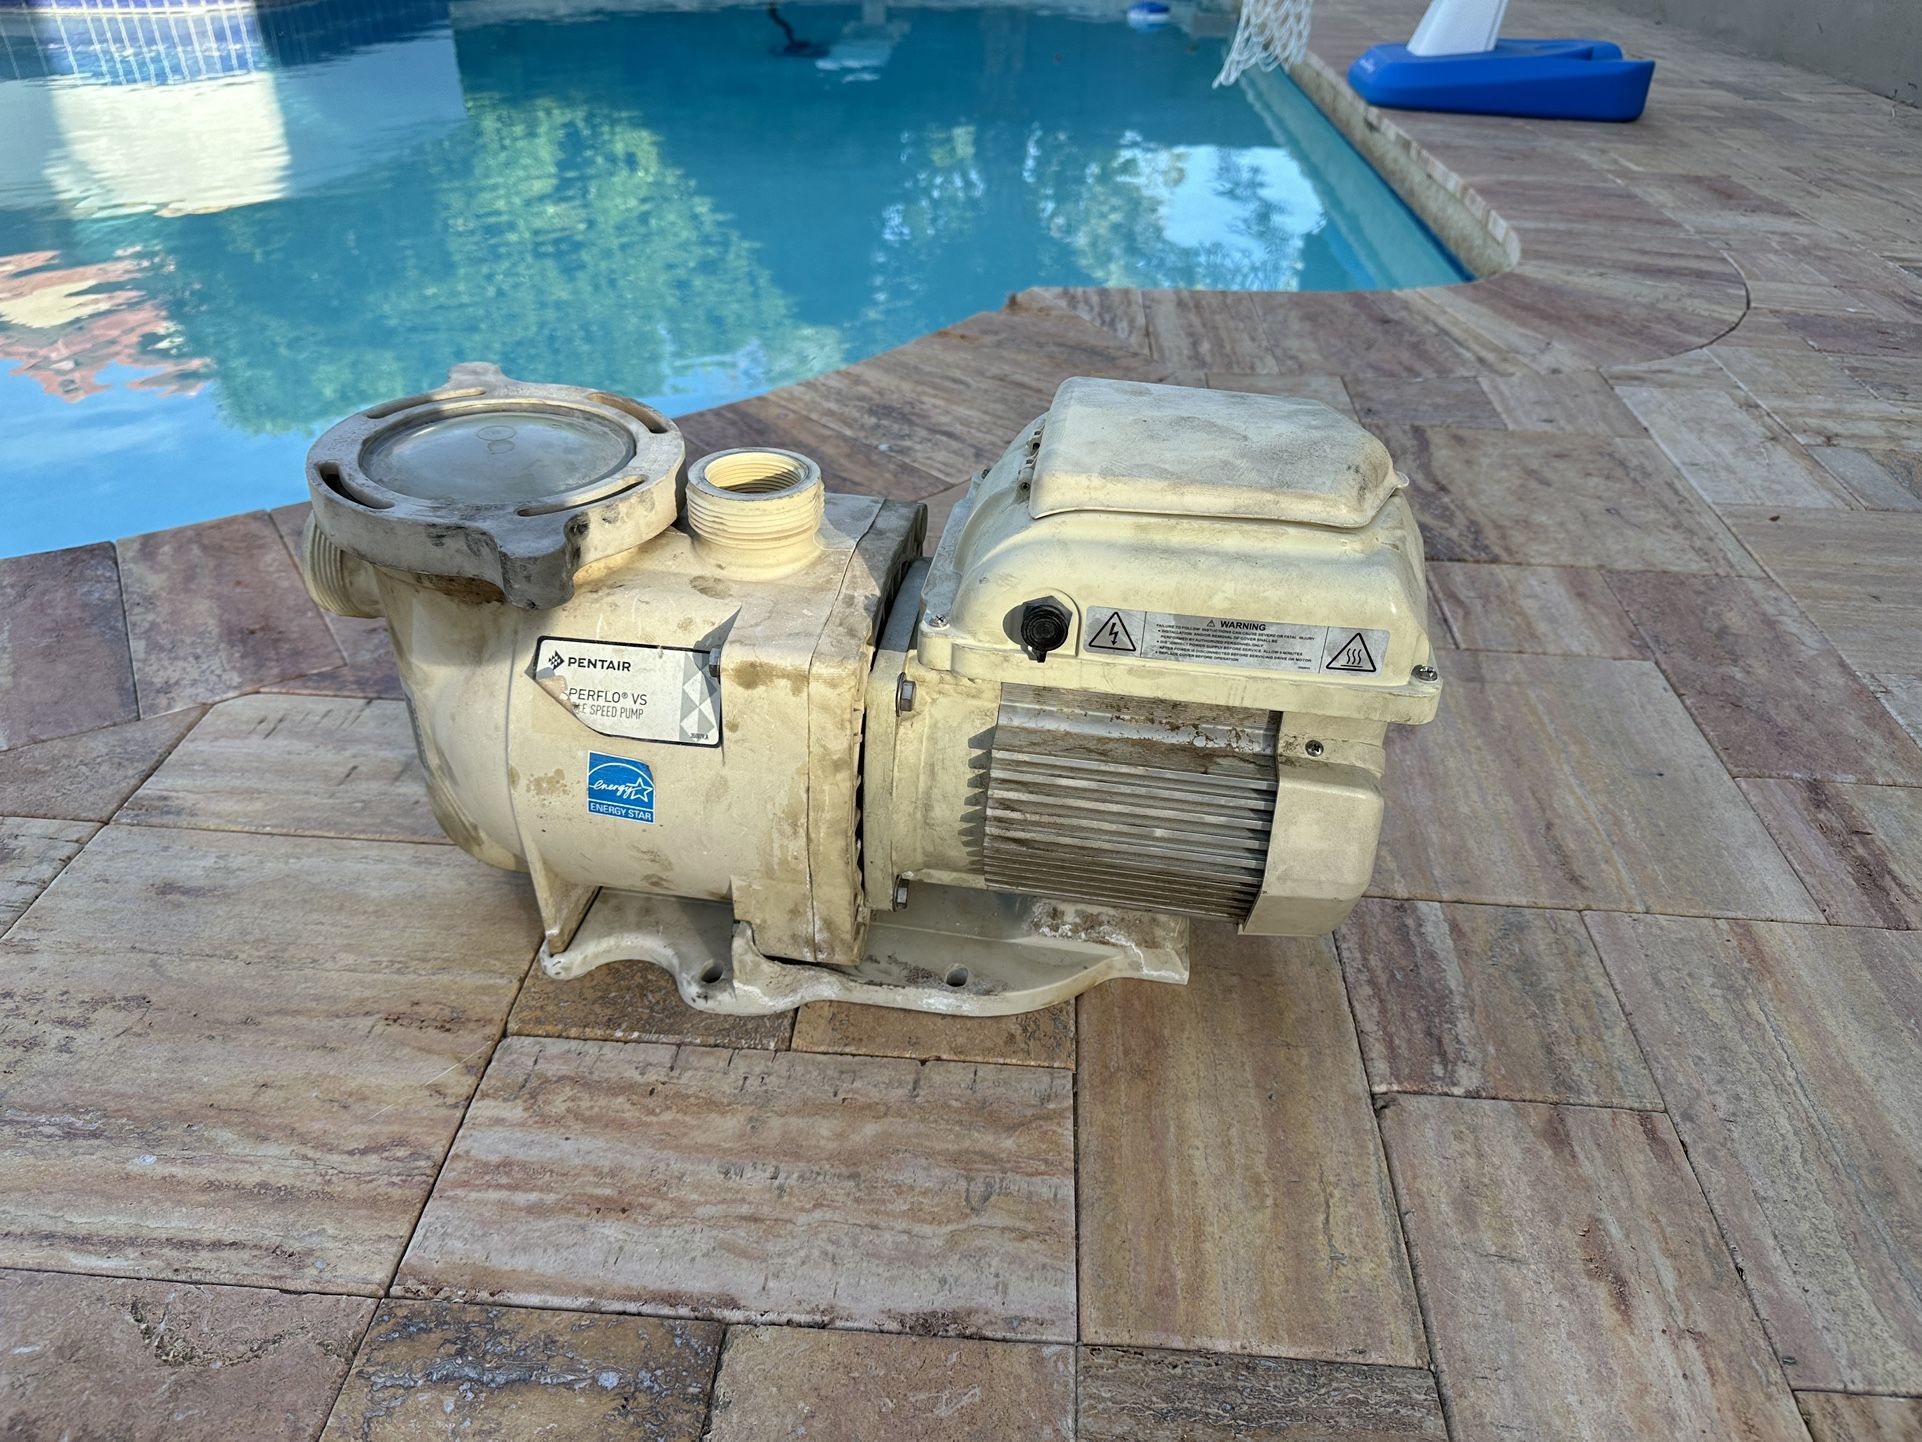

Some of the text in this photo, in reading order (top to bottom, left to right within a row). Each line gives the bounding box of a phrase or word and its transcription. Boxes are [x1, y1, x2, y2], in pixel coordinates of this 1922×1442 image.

[1220, 620, 1266, 631] WARNING
[568, 657, 631, 672] PENTAIR
[632, 693, 647, 706] VS
[589, 704, 617, 718] SPEED
[619, 707, 644, 719] PUMP
[590, 779, 638, 799] energy
[590, 802, 651, 821] ENERGY STAR
